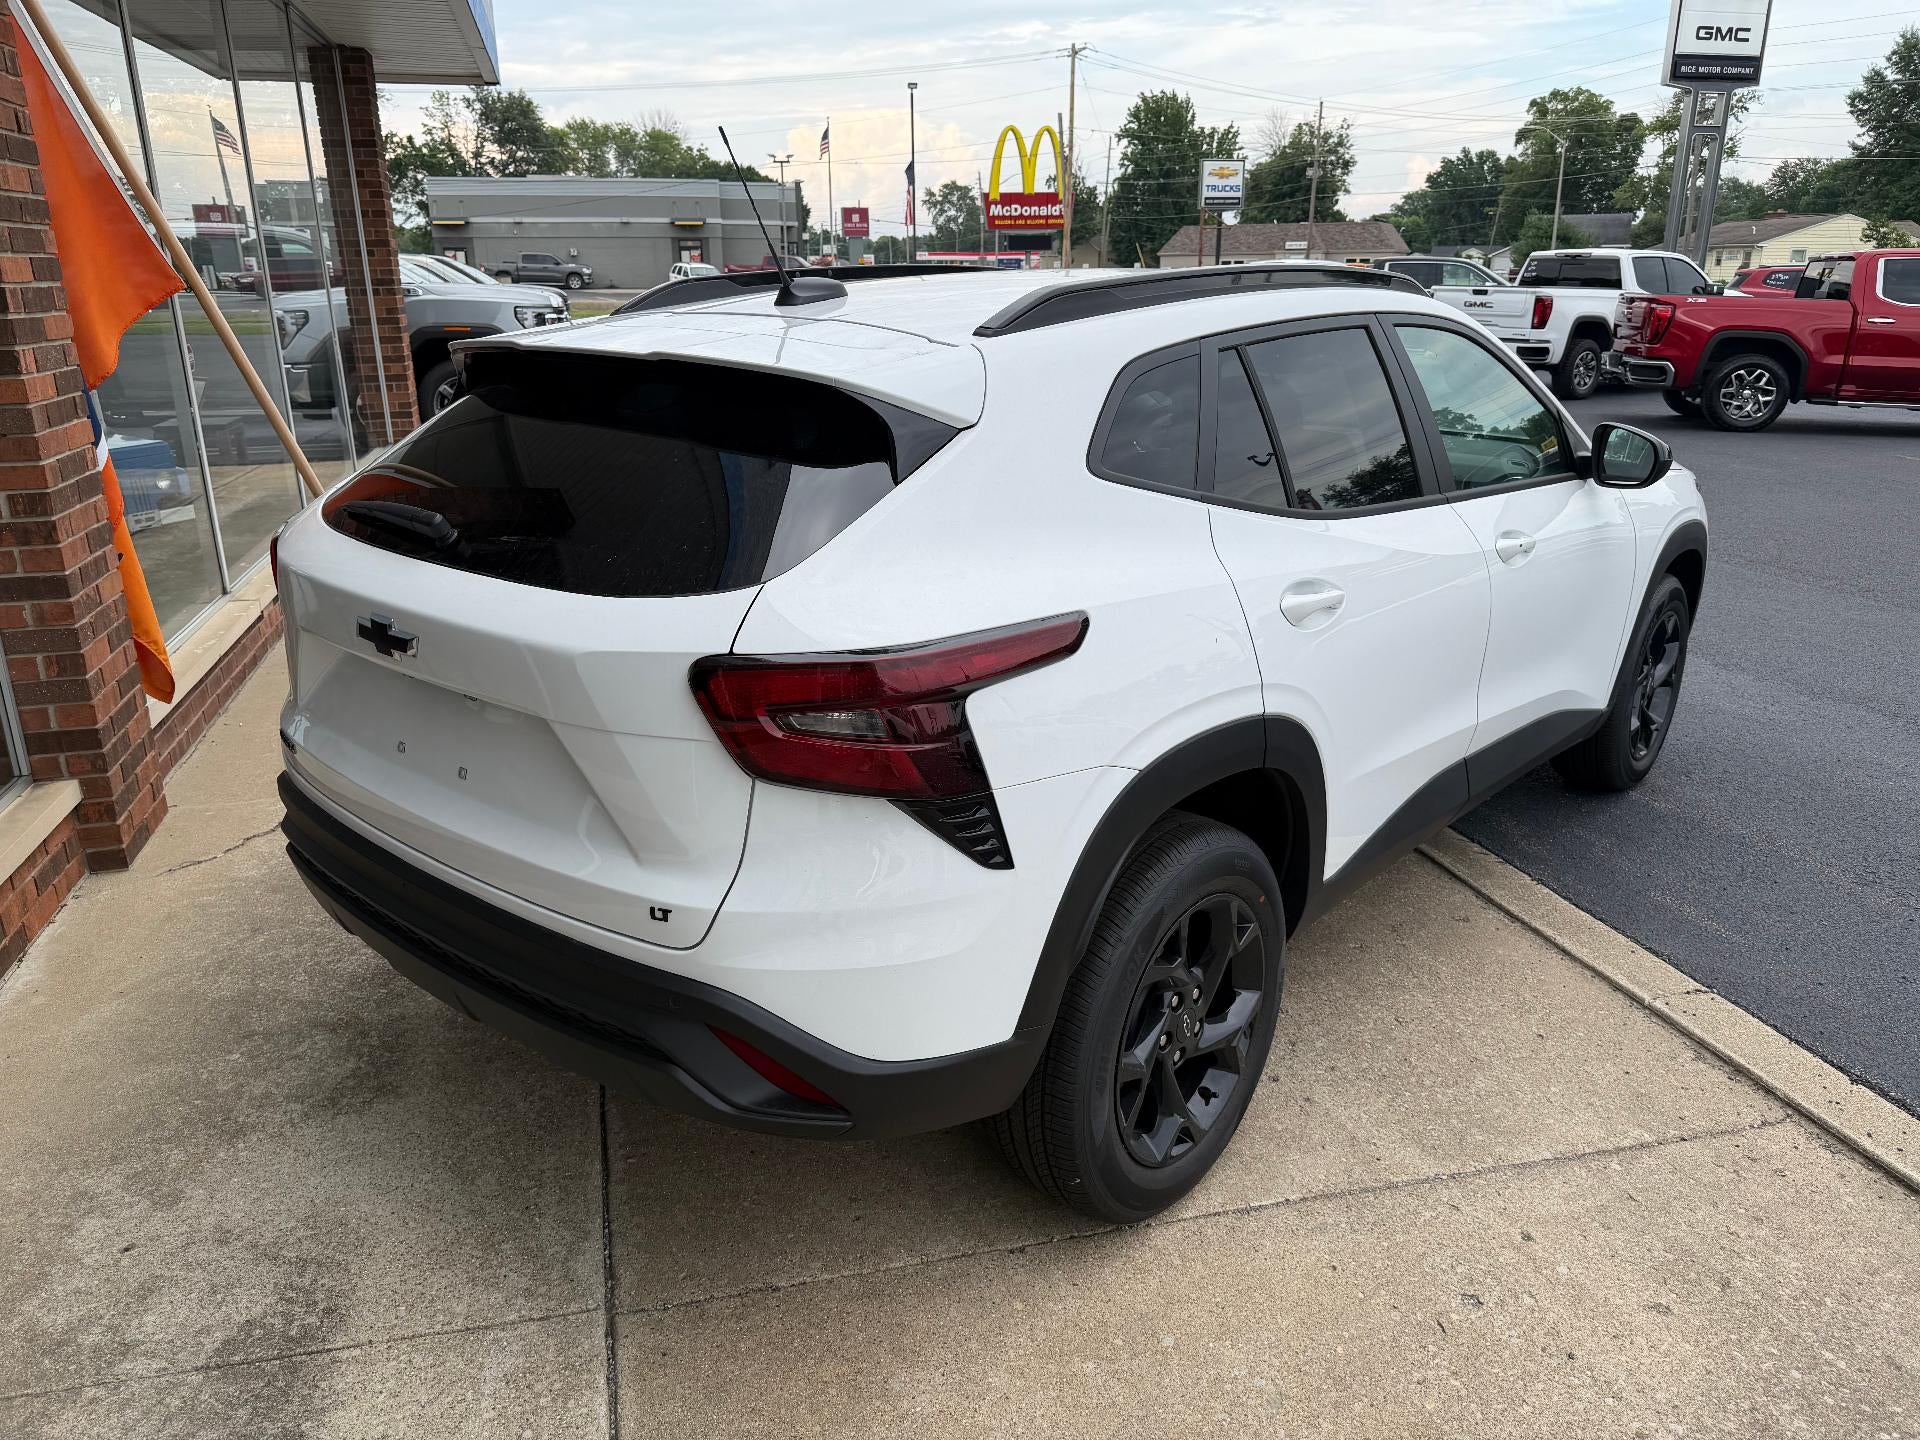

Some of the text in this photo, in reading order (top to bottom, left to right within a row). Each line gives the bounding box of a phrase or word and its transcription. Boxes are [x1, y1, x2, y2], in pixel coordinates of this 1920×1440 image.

[1695, 25, 1752, 43] GMC
[1680, 65, 1754, 75] RICE MOTOR COMPANY
[1205, 184, 1241, 193] TRUCKS
[1464, 300, 1495, 309] GMC
[649, 906, 673, 923] LT
